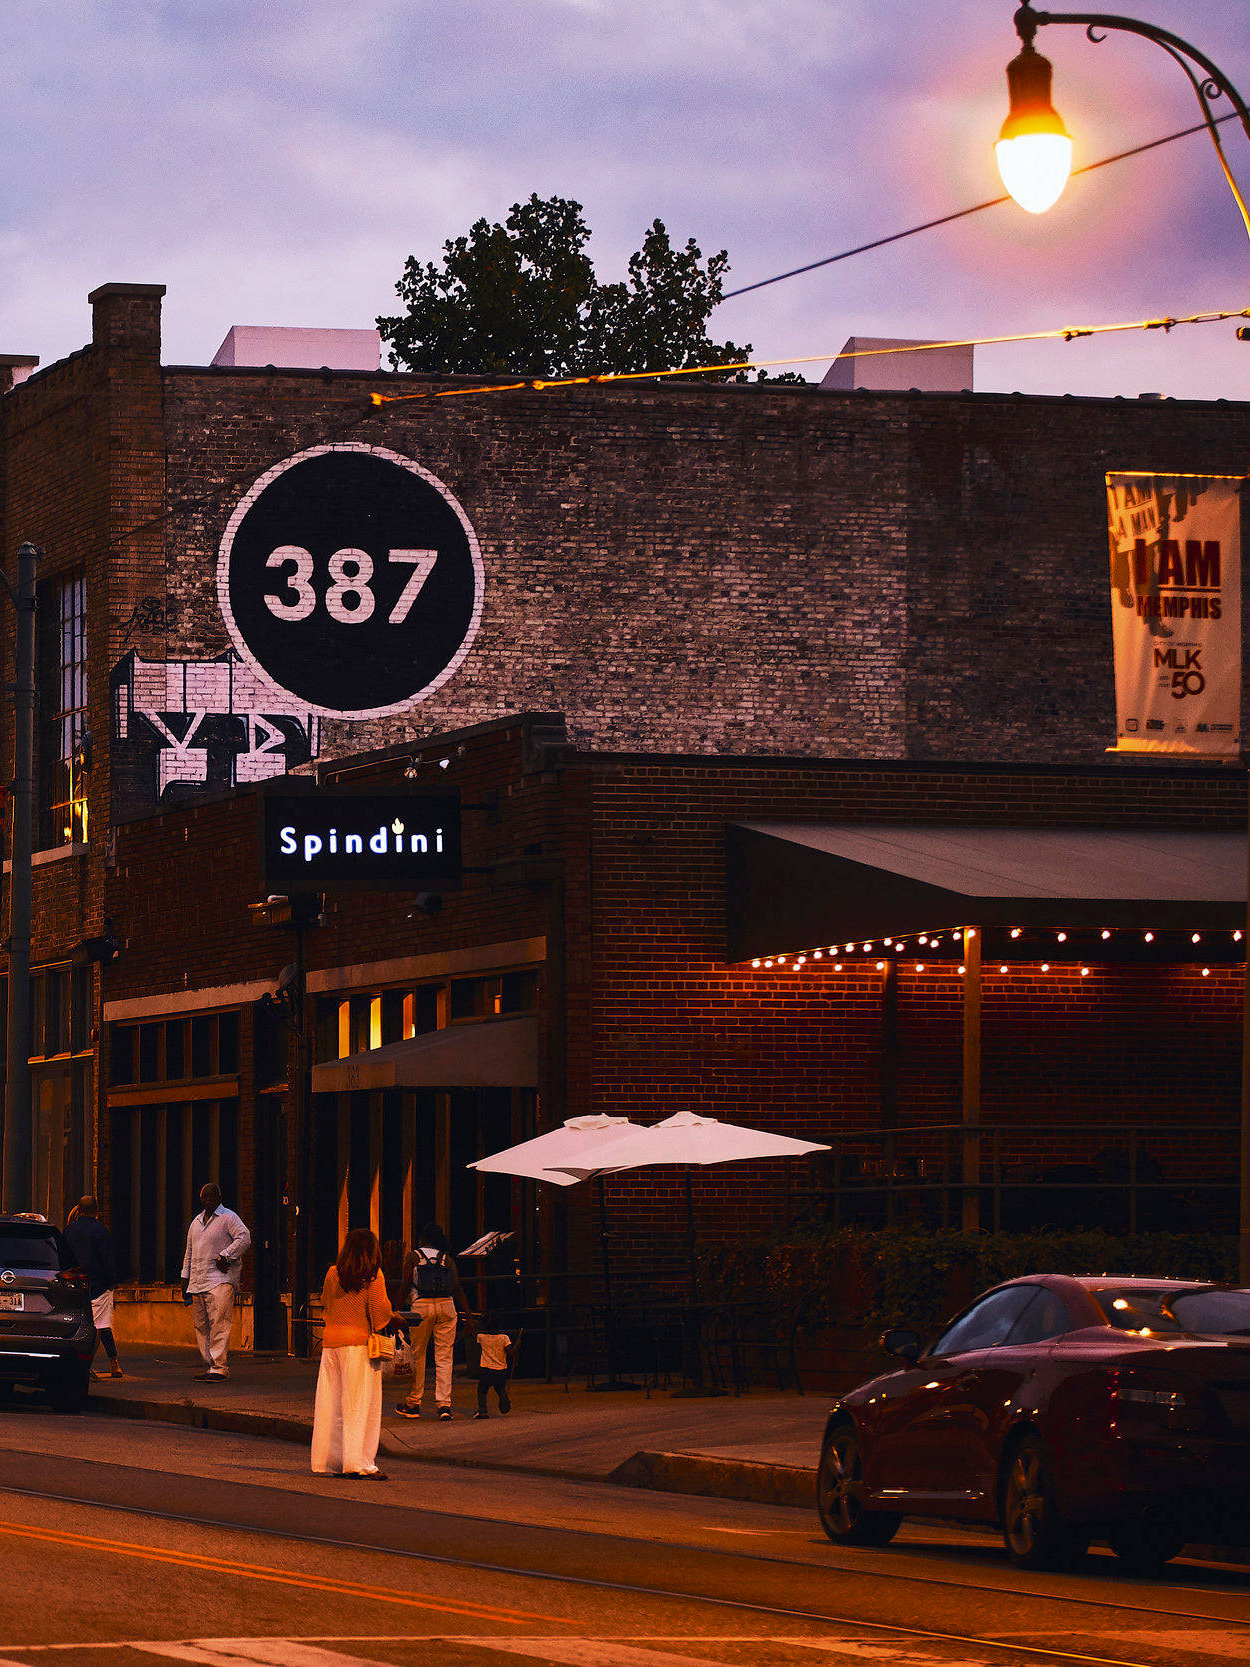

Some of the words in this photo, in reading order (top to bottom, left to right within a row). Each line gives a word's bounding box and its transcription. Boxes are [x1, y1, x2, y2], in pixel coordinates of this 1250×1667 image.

[1158, 539, 1221, 588] AM
[264, 545, 438, 624] 387
[1136, 596, 1222, 620] MEMPHIS
[1154, 648, 1202, 670] MLK
[1171, 670, 1205, 699] 50
[280, 818, 443, 862] Spindini
